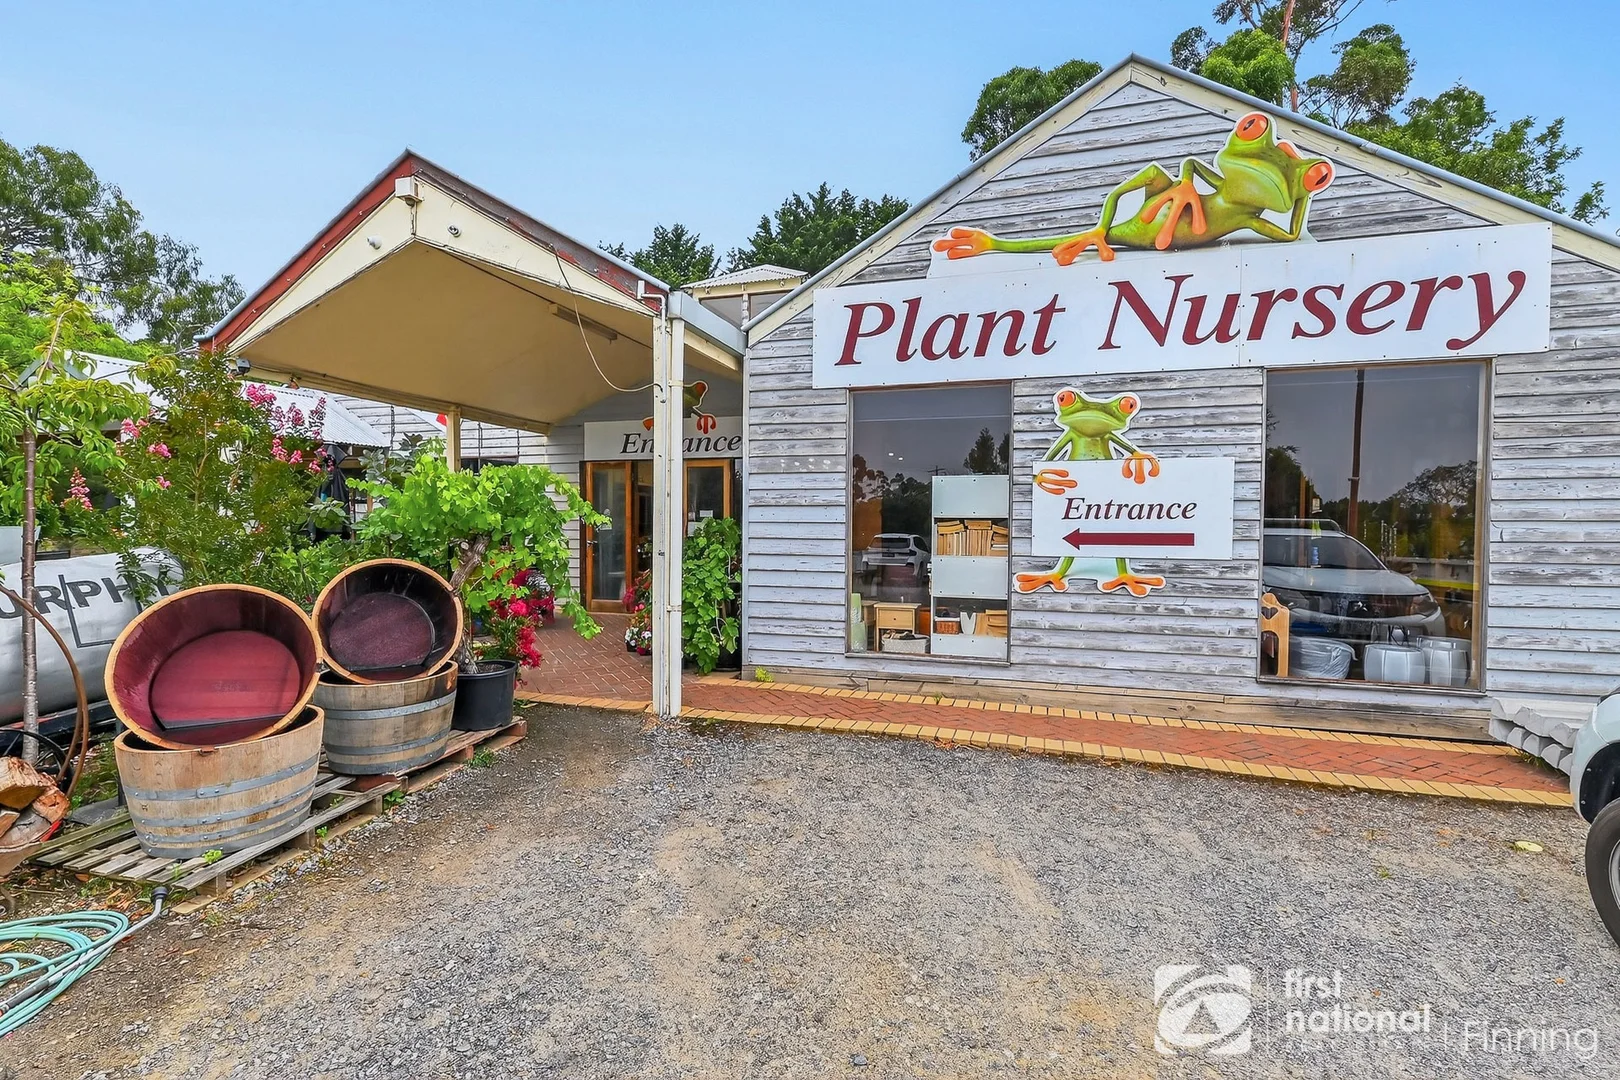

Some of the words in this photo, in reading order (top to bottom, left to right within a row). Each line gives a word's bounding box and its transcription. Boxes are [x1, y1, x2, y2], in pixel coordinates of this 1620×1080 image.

[834, 293, 1066, 366] Plant
[1098, 270, 1527, 351] Nursery
[620, 432, 742, 454] Enance
[1061, 497, 1198, 520] Entrance
